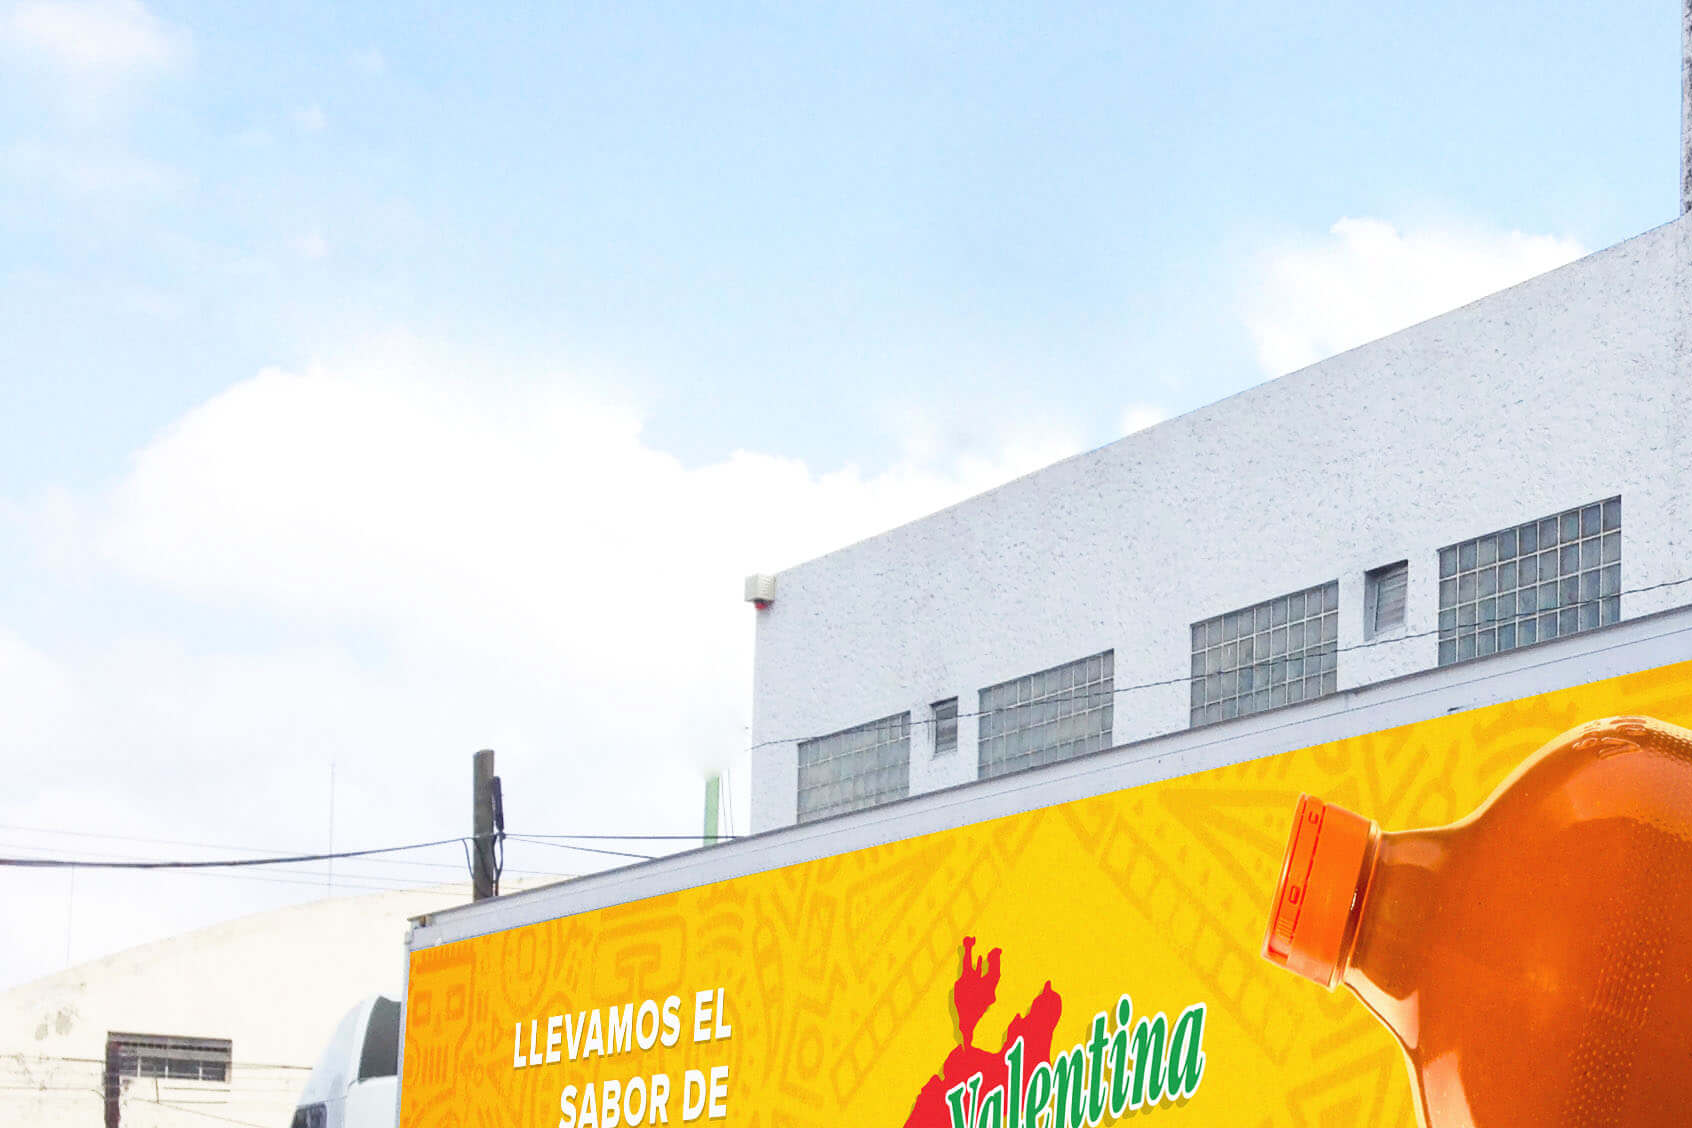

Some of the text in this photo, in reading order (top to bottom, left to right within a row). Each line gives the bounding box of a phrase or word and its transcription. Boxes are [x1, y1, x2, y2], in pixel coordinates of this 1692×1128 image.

[513, 987, 732, 1069] LLEVAMOS EL
[682, 1065, 729, 1121] DE
